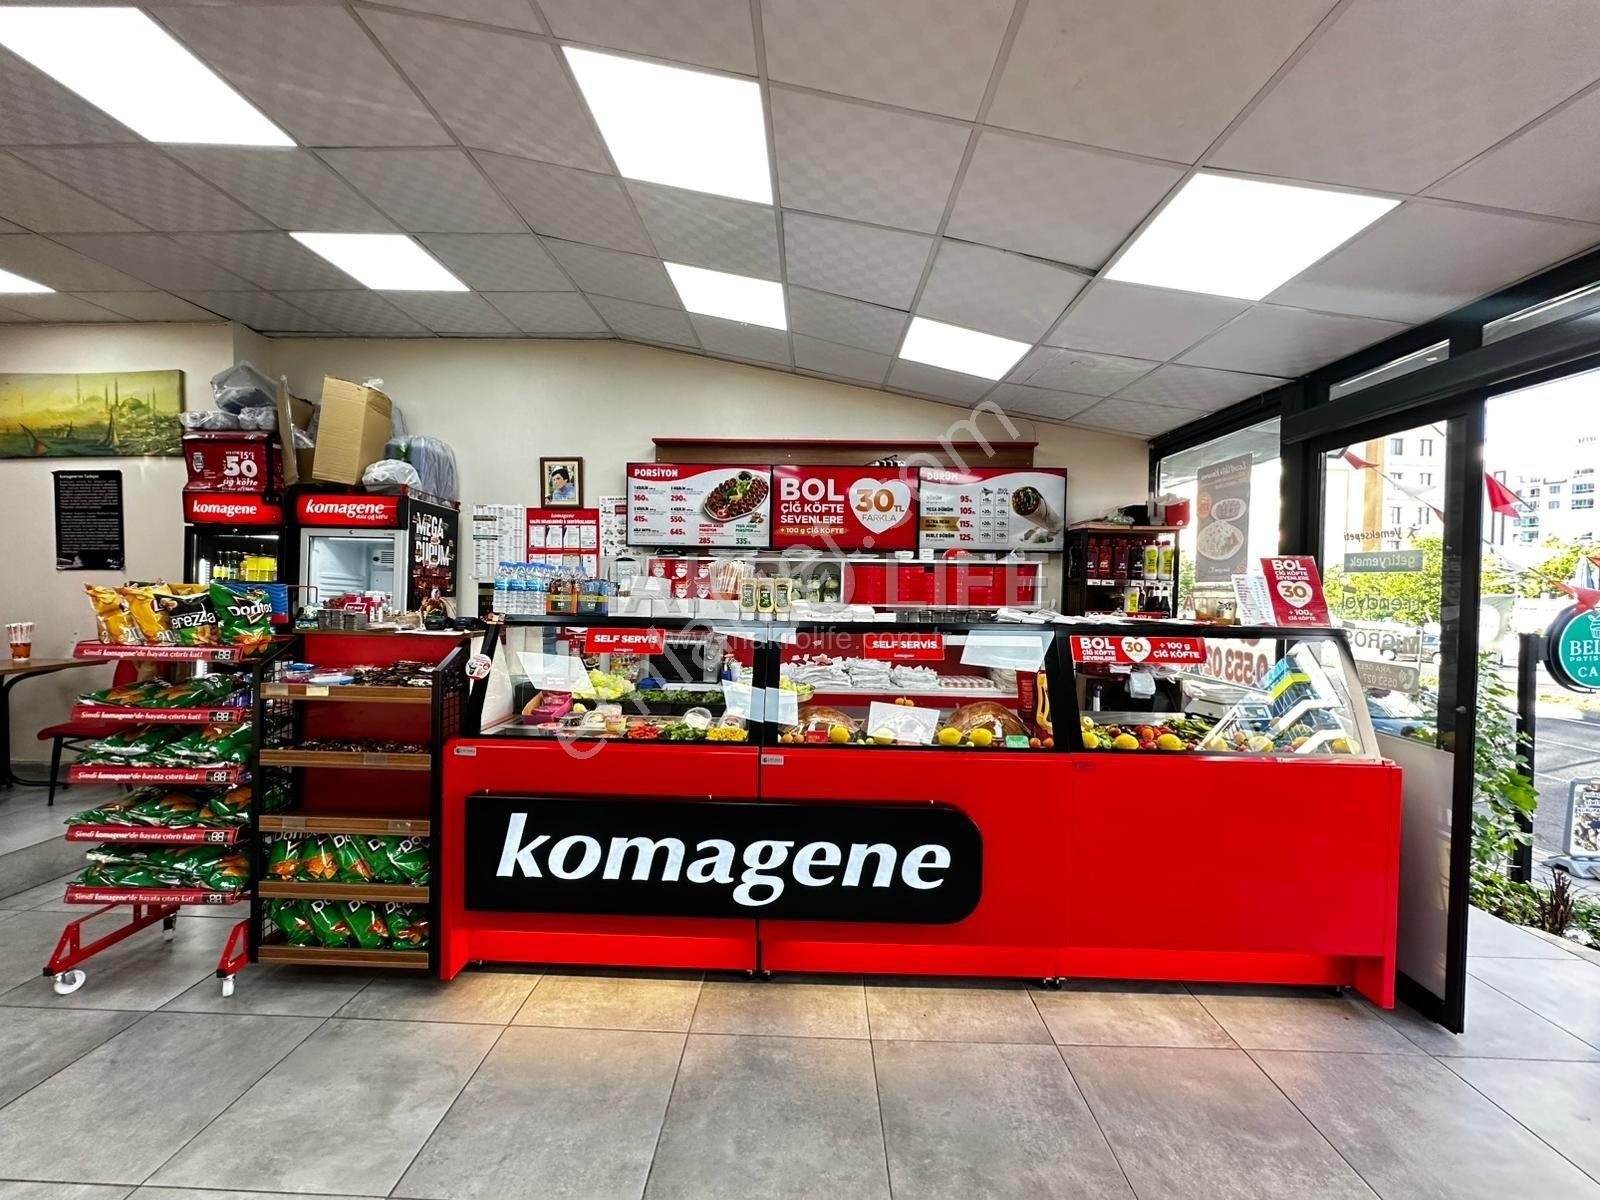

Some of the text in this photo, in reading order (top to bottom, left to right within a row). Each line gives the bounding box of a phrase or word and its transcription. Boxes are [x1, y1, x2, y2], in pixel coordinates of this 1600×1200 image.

[224, 455, 258, 478] 50
[634, 468, 678, 477] PORSİYON
[780, 478, 845, 501] BOL
[192, 500, 258, 517] komagene
[305, 499, 385, 519] komagene
[780, 500, 845, 514] ÇİĞ KÖFTE
[780, 515, 844, 524] SEVENLERE
[862, 514, 897, 522] FARKLA
[416, 511, 444, 539] MEGA
[1271, 560, 1307, 571] BOL
[1281, 585, 1307, 598] 30
[227, 602, 273, 617] Doritos
[594, 633, 658, 643] SELF SERVİS
[872, 639, 938, 649] SELF SERVİS
[1080, 637, 1116, 650] BOL
[1124, 642, 1143, 653] 30
[1153, 650, 1200, 659] ÇİĞ KÖFTE
[1577, 666, 1599, 678] CA
[496, 812, 951, 906] komagene
